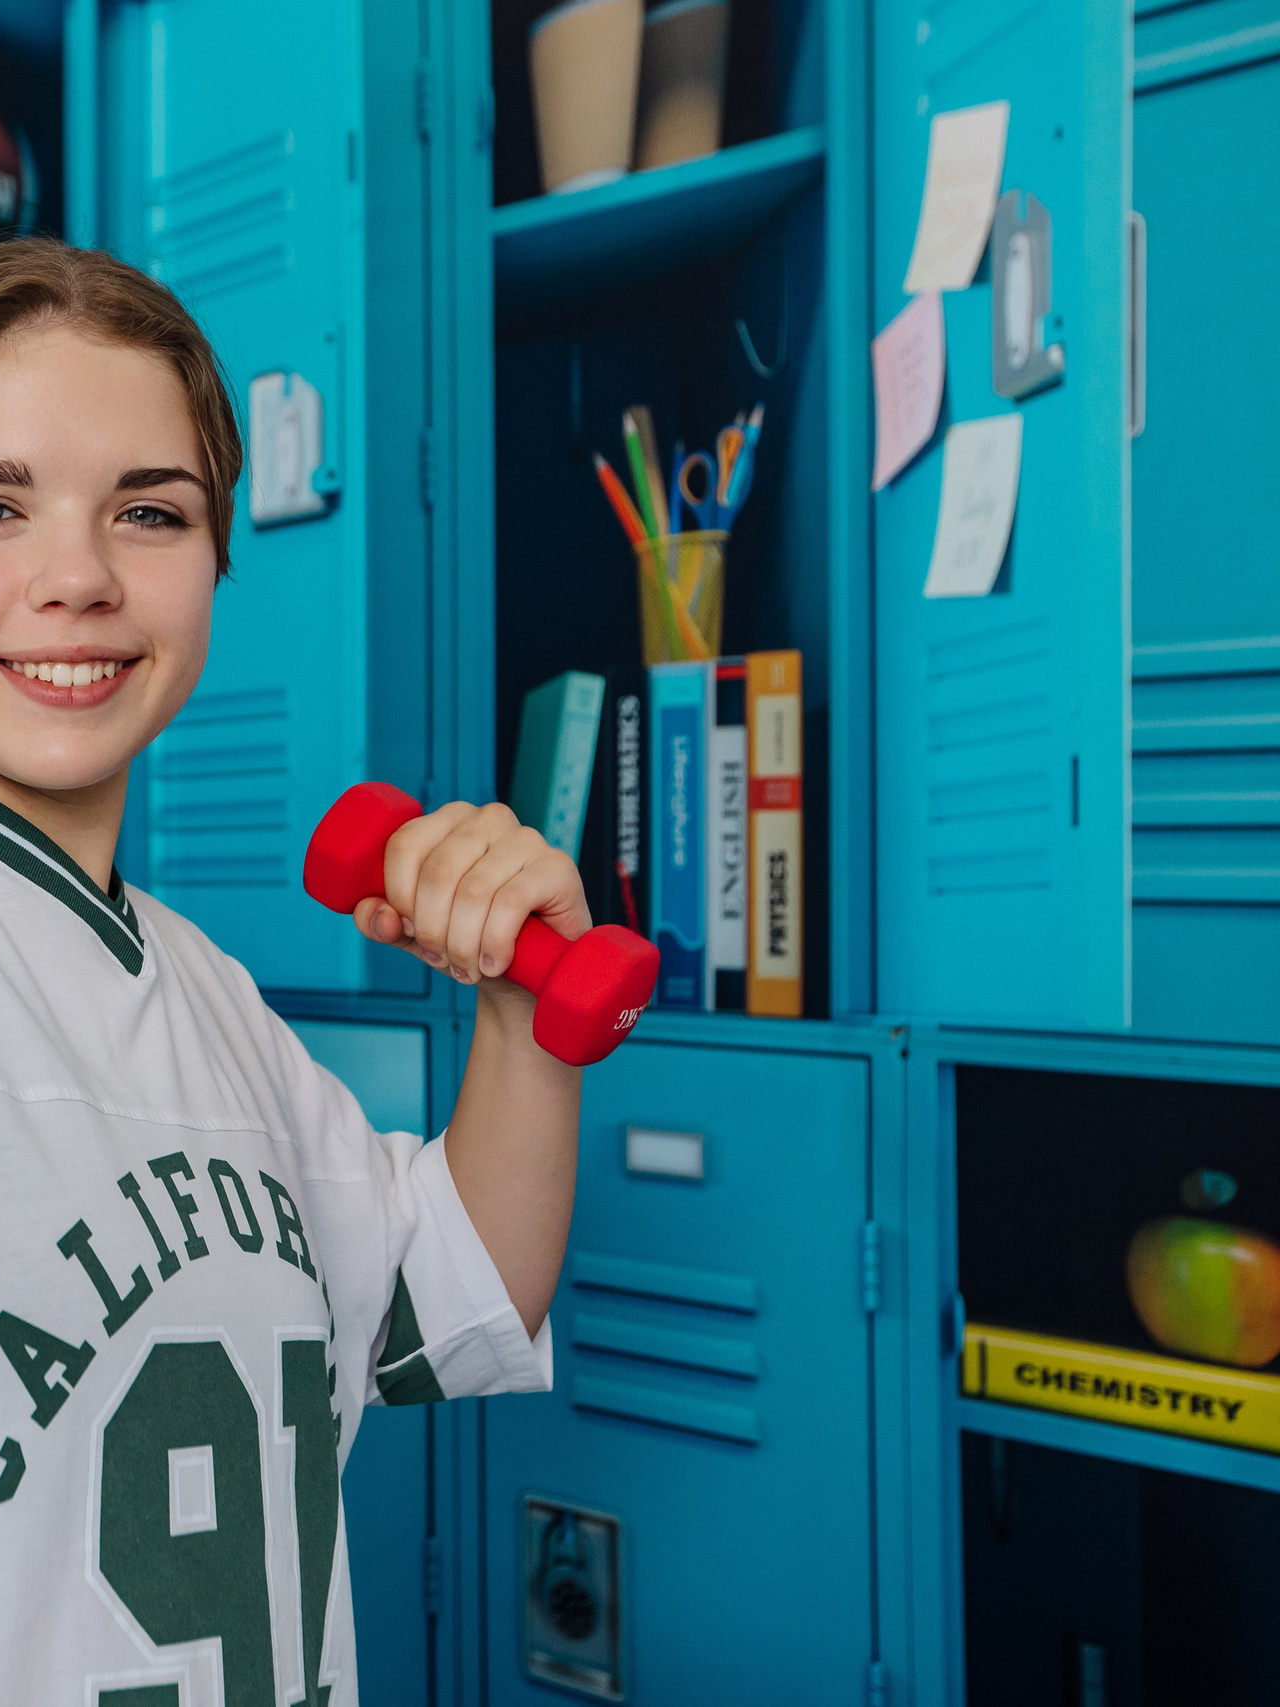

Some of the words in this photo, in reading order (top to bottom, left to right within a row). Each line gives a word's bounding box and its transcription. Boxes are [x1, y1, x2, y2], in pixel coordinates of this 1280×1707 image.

[619, 695, 640, 875] MATHEMATICS
[723, 761, 743, 920] ENGLISH
[769, 851, 787, 957] PHYSICS
[1014, 1362, 1244, 1423] CHEMISTRY
